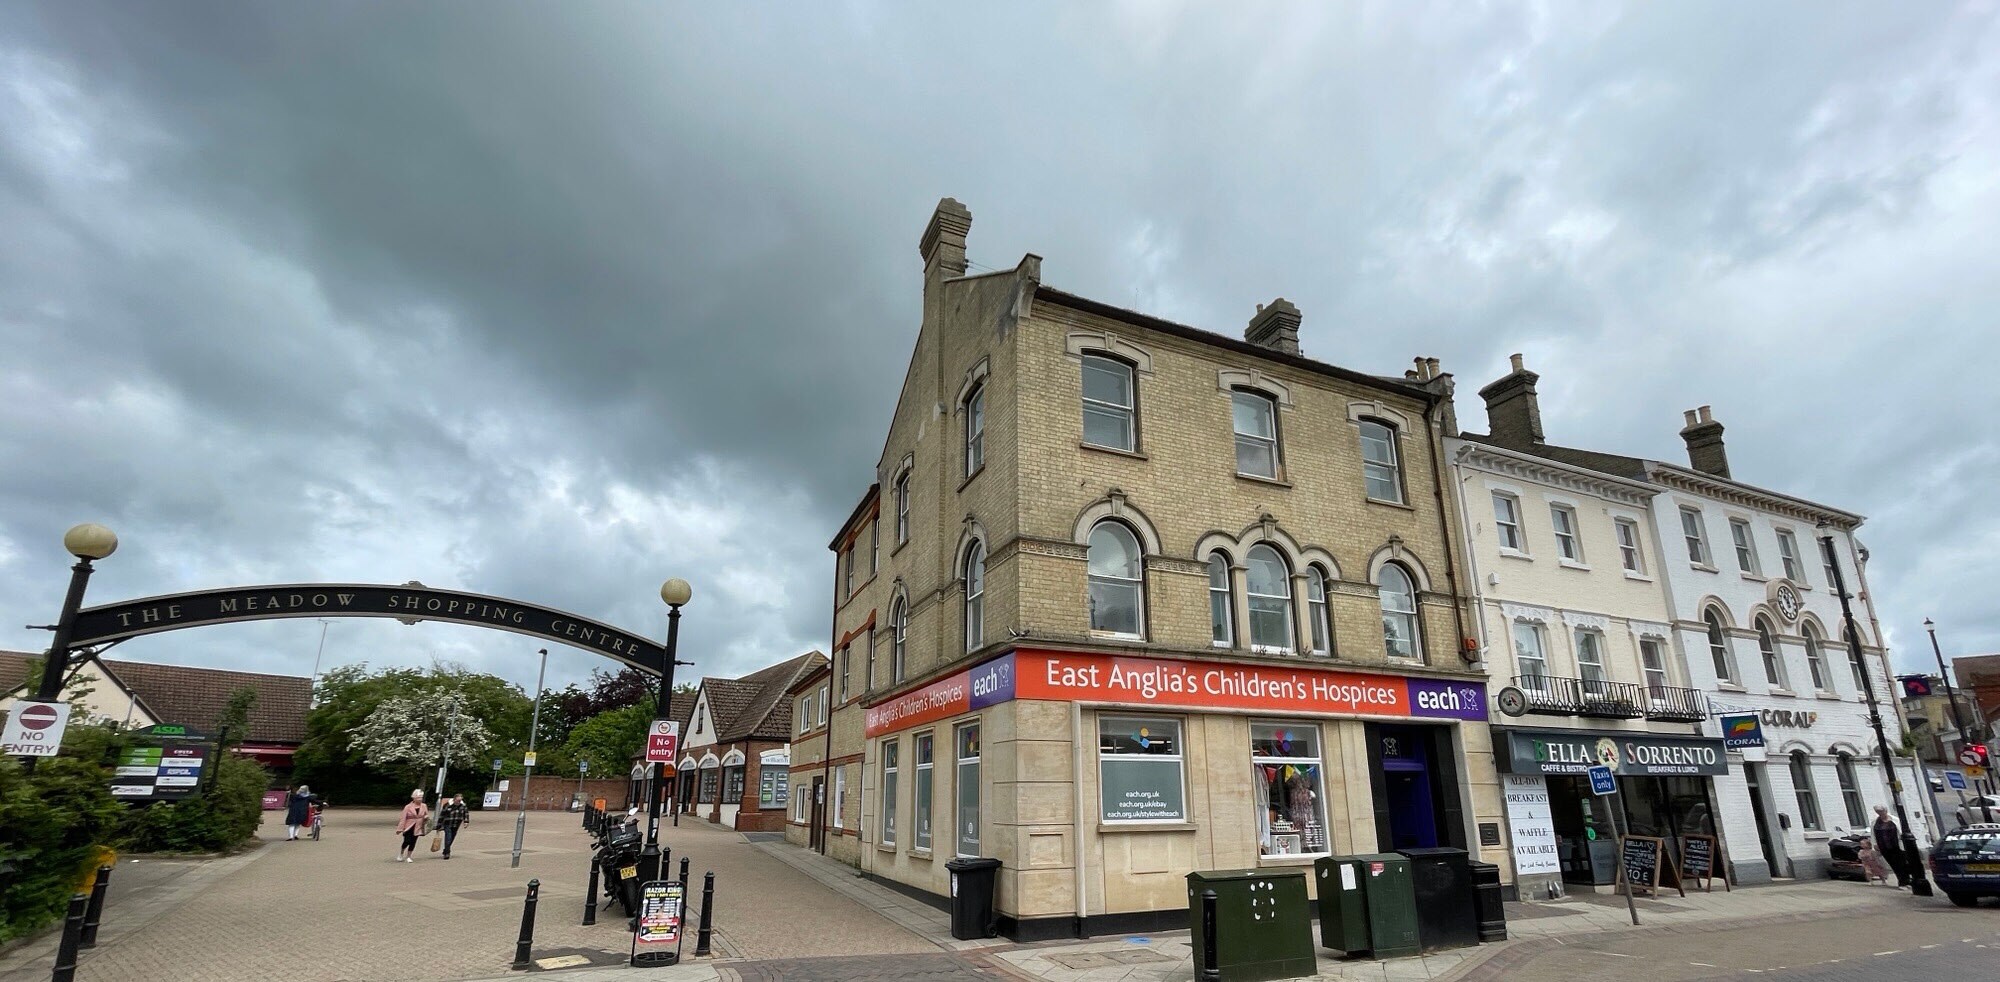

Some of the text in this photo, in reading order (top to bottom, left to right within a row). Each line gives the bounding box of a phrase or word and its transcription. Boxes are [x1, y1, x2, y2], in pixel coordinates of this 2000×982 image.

[118, 593, 639, 656] THE MEADOW SHOPPING CENTRE
[974, 667, 998, 697] each
[1047, 660, 1396, 709] East Anglia's Children's Hospices
[1418, 687, 1460, 711] each
[869, 684, 963, 728] East Anglia's Children's Hospices
[1761, 709, 1811, 728] CORAL
[151, 726, 186, 734] ASDA
[20, 731, 45, 741] NO
[656, 738, 670, 746] No
[2, 743, 56, 753] ENTRY
[650, 748, 674, 757] entry
[1533, 739, 1716, 765] BELLA SORRENTO
[1541, 764, 1560, 772] CAFFE
[1566, 765, 1588, 773] BISTRO
[1647, 765, 1676, 773] BREAKFAST
[1592, 770, 1610, 780] Taxis
[1511, 777, 1540, 786] ALL-DAY
[1597, 780, 1612, 790] only
[1125, 791, 1160, 799] each.org.uk
[1507, 793, 1548, 802] BREAKFAST
[1118, 800, 1167, 809] each.org.uk/ebay
[1527, 811, 1534, 819] &
[1518, 827, 1548, 837] WAFFLE
[1516, 844, 1556, 855] AVAILABLE
[1627, 868, 1641, 880] 10
